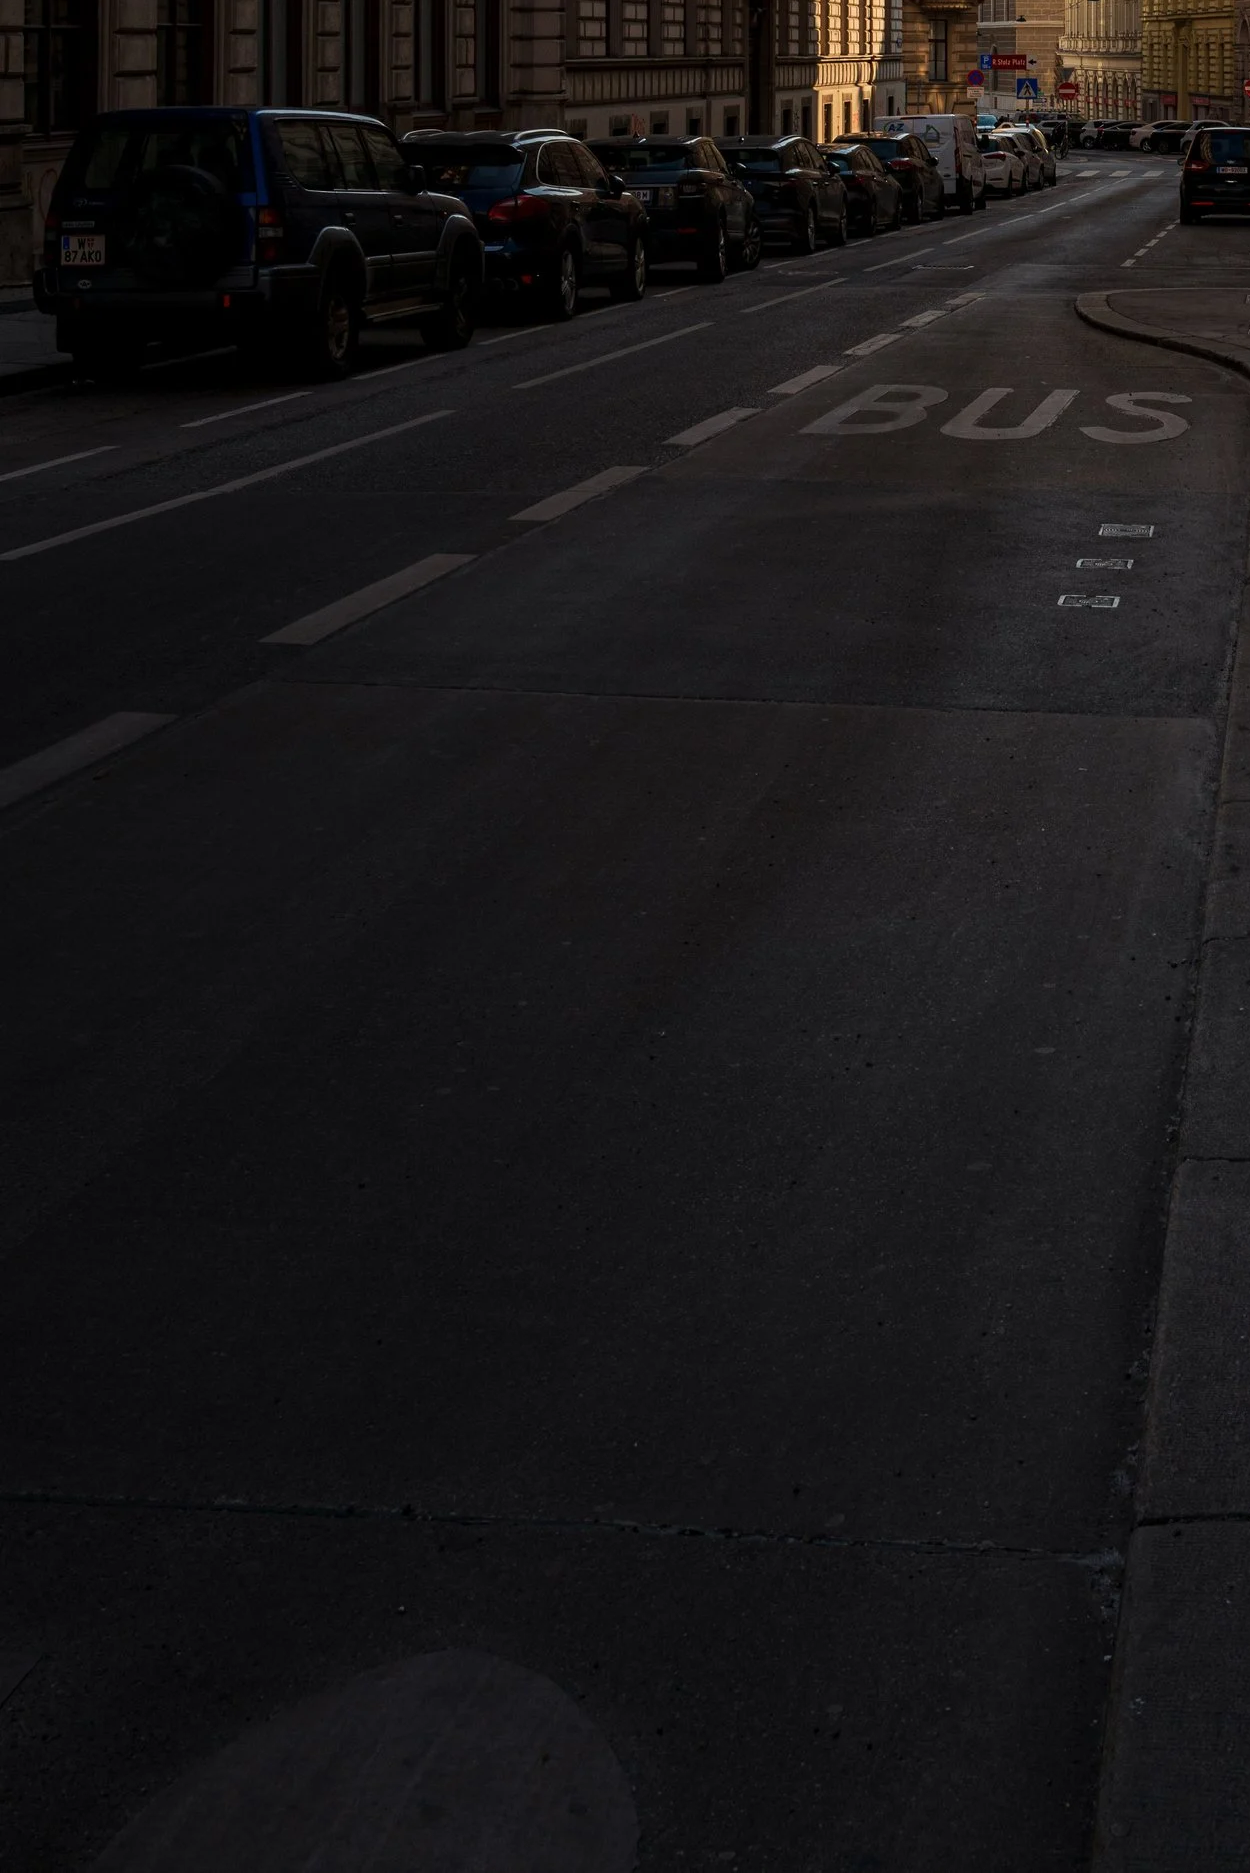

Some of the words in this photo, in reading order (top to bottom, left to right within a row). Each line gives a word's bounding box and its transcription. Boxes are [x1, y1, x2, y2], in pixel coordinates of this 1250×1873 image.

[77, 238, 86, 249] W
[64, 251, 78, 262] 87
[799, 384, 1193, 444] BUS
